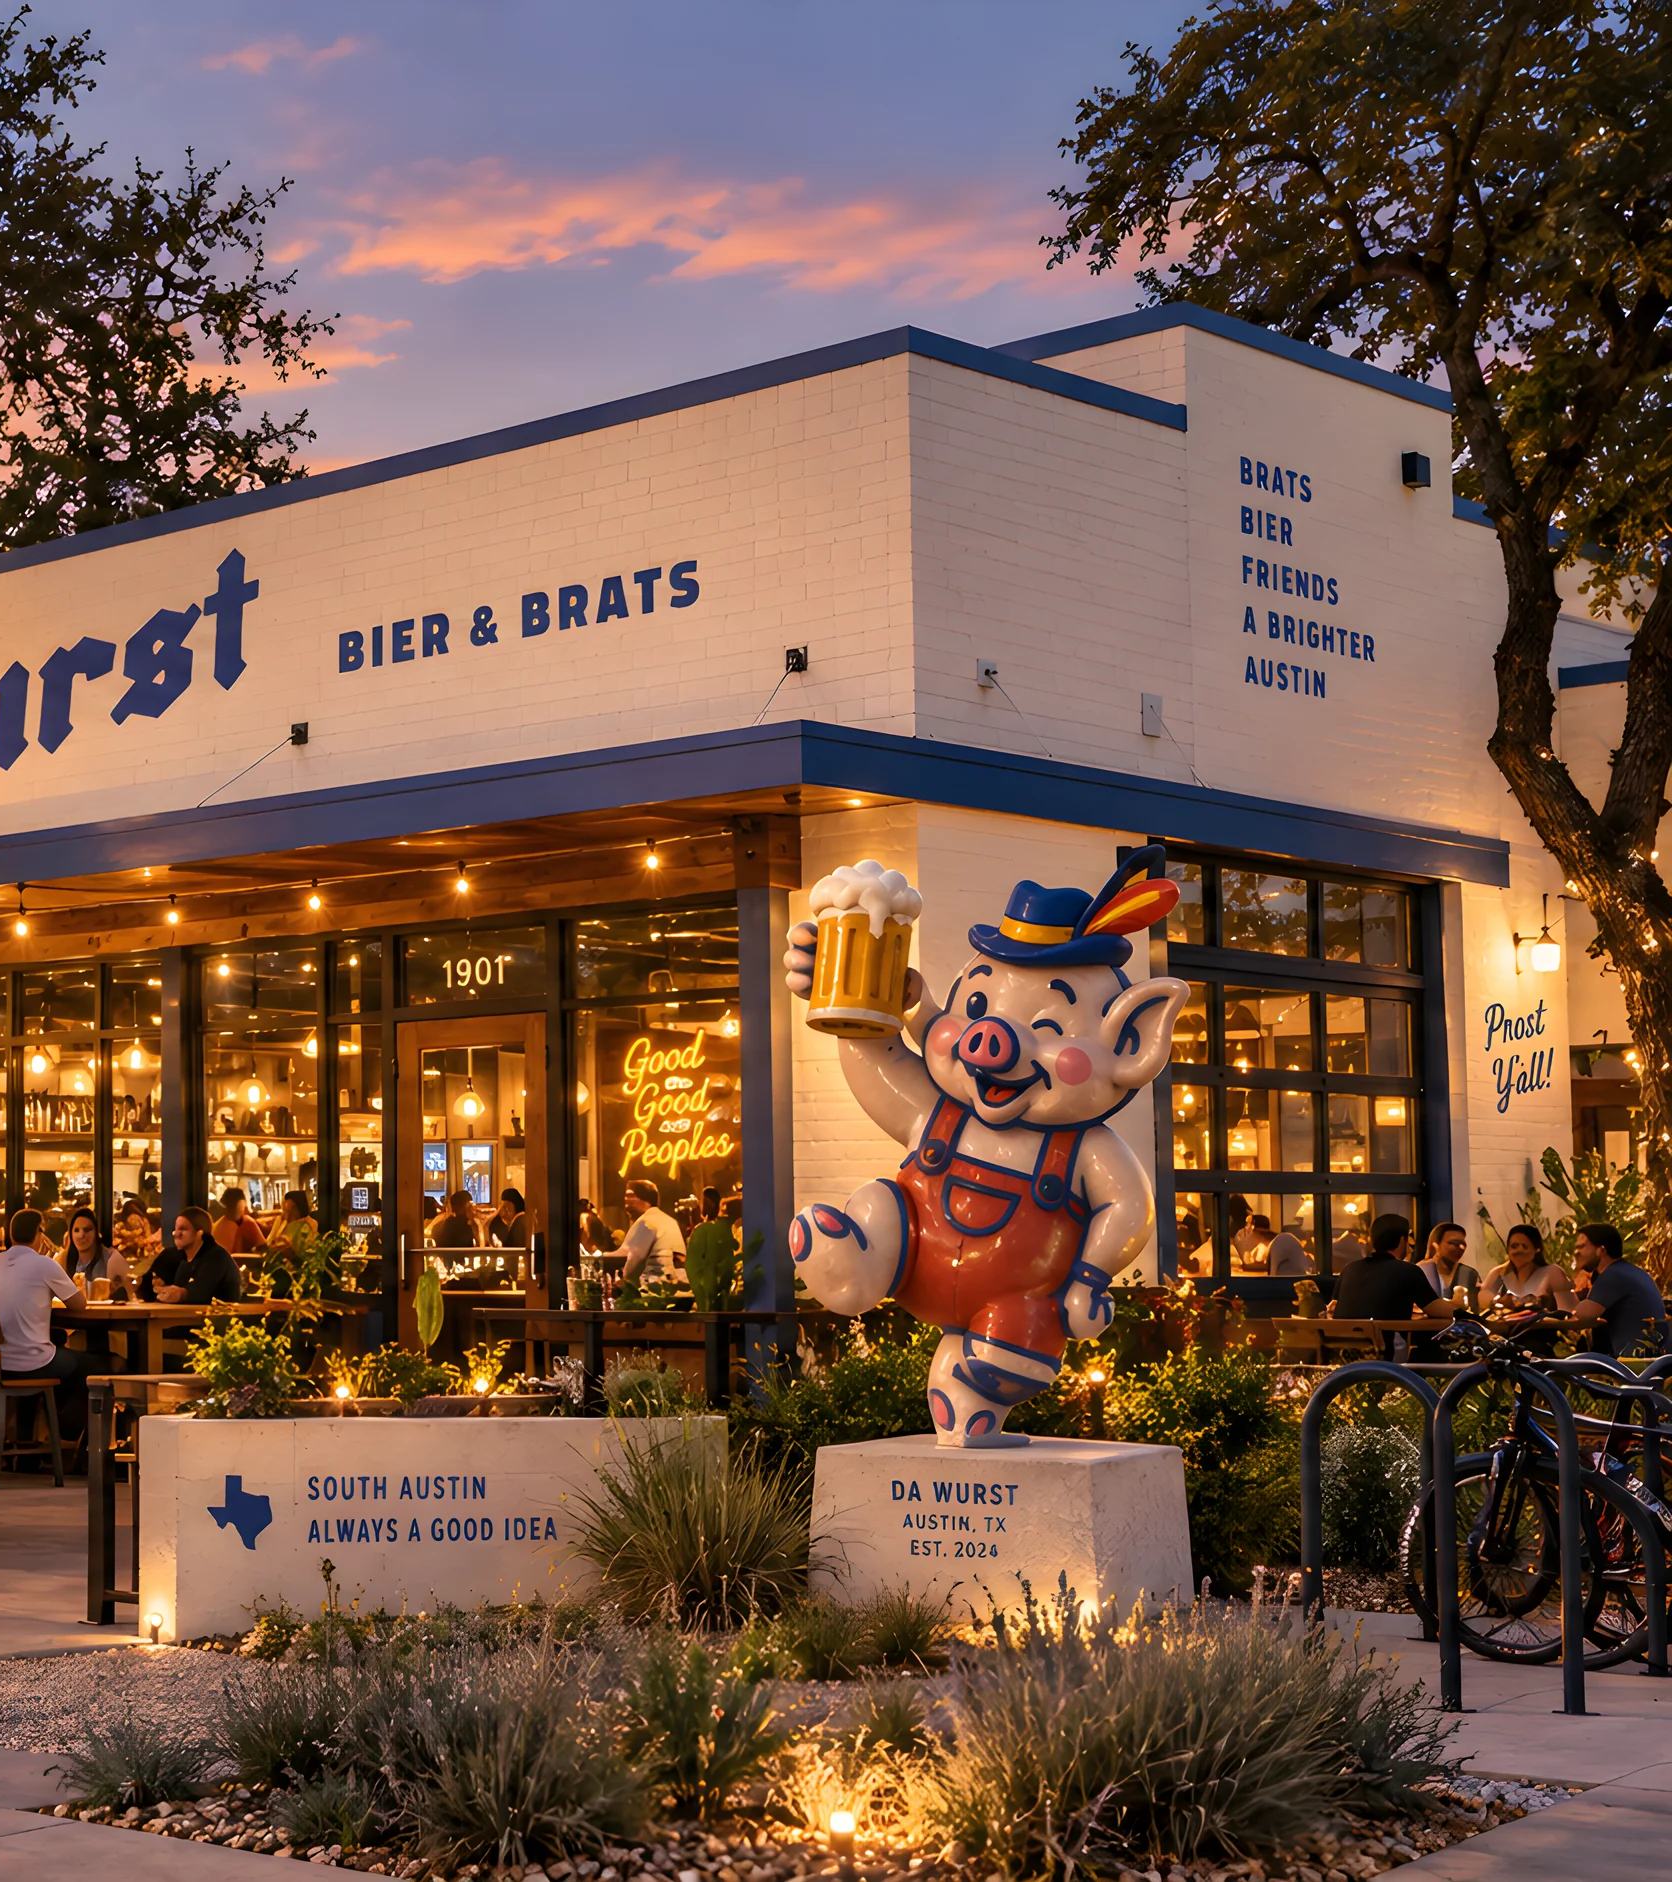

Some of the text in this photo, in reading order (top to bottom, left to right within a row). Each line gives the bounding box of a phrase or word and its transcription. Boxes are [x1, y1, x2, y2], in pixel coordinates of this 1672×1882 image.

[1239, 455, 1312, 503] BRATS
[1240, 505, 1293, 547] BIER
[1242, 555, 1339, 606] FRIENDS
[338, 560, 701, 673] BIER & BRATS
[1242, 606, 1375, 662] A BRIGHTER
[1244, 656, 1326, 699] AUSTIN
[442, 955, 504, 988] 1901
[1484, 999, 1548, 1052] Prost
[622, 1028, 706, 1095] Good
[634, 1077, 712, 1128] Good
[618, 1121, 735, 1180] Peoples
[307, 1475, 487, 1501] SOUTH AUSTIN
[891, 1480, 1019, 1506] DA WURST
[308, 1516, 558, 1543] ALWAYS A GOOD IDEA
[984, 1517, 1006, 1533] TX
[911, 1539, 947, 1557] EST.
